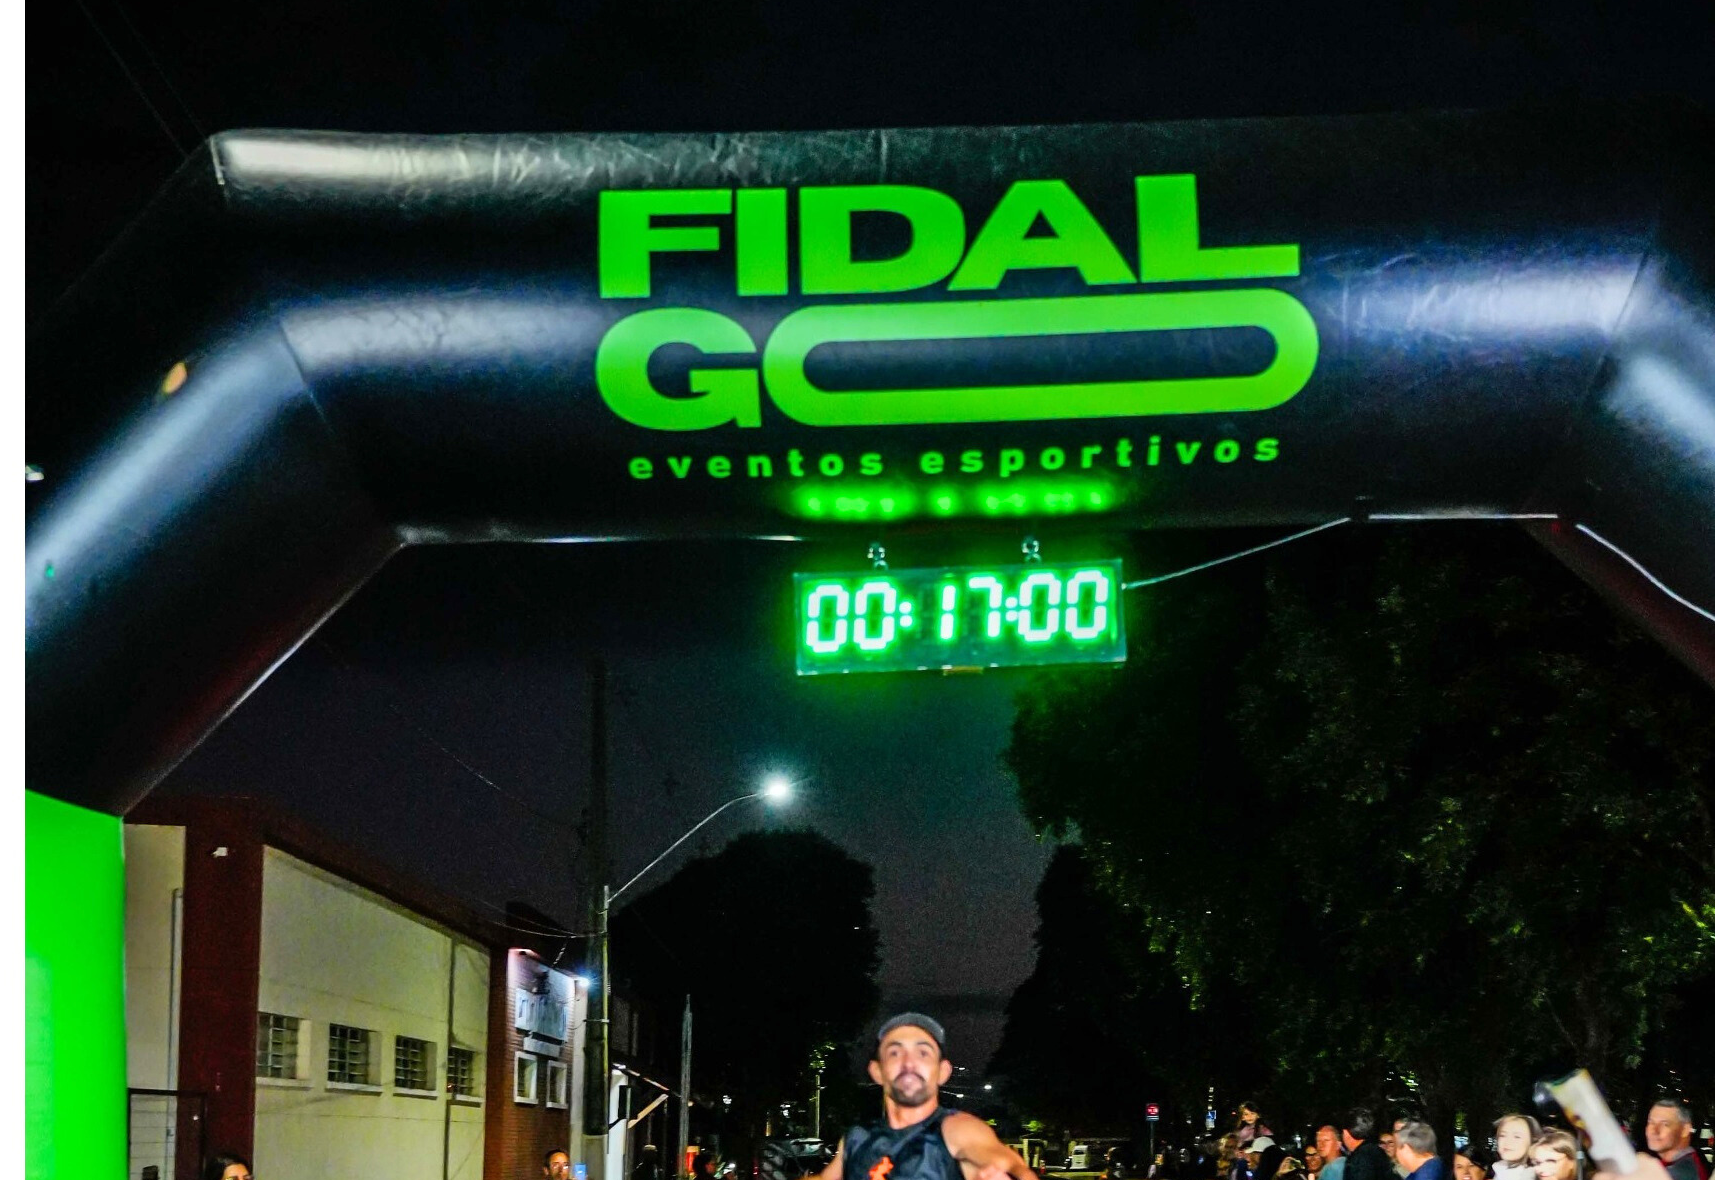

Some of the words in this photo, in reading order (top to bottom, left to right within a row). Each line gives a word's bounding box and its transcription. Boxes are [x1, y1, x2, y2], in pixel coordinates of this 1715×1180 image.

[598, 174, 1300, 298] FIDAL
[629, 448, 884, 480] eventos
[919, 436, 1279, 476] esportivos
[806, 569, 1111, 654] 00:17:00
